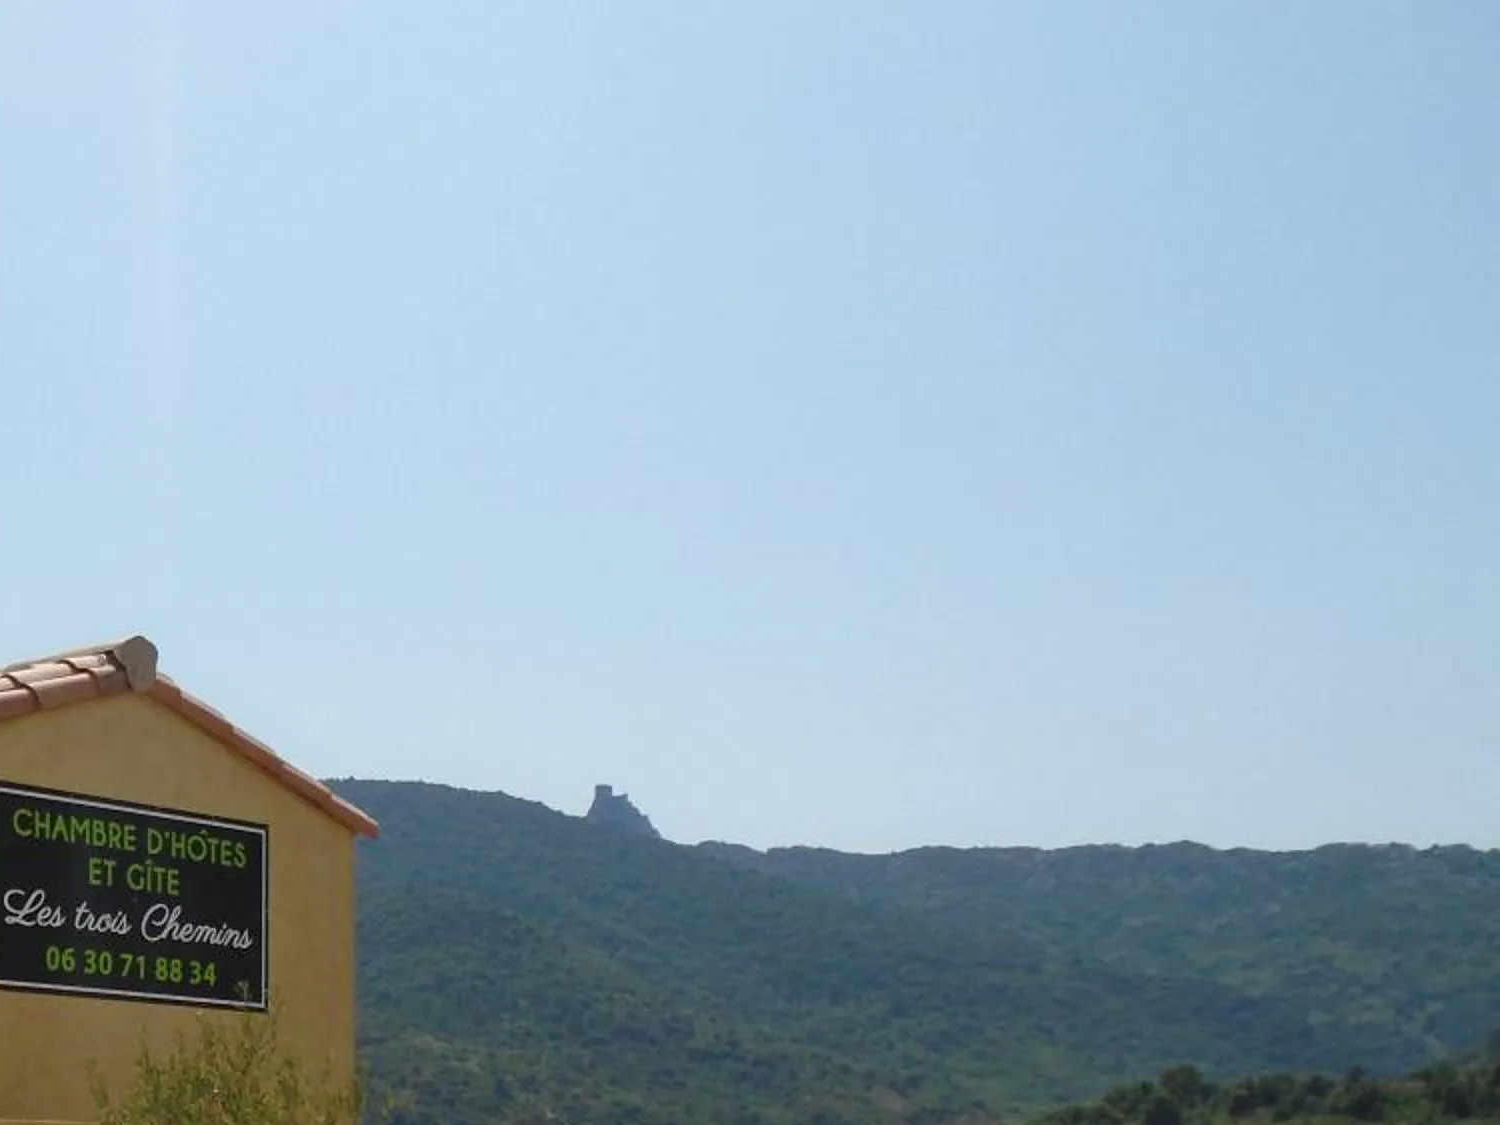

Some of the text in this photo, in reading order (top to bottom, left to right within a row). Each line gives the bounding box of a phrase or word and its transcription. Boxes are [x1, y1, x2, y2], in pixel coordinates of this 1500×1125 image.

[13, 808, 247, 868] CHAMBRE D'HÔTES
[89, 857, 180, 895] ET GÎTE
[3, 889, 252, 949] Les trois Chemins
[46, 946, 217, 987] 06 30 71 88 34
